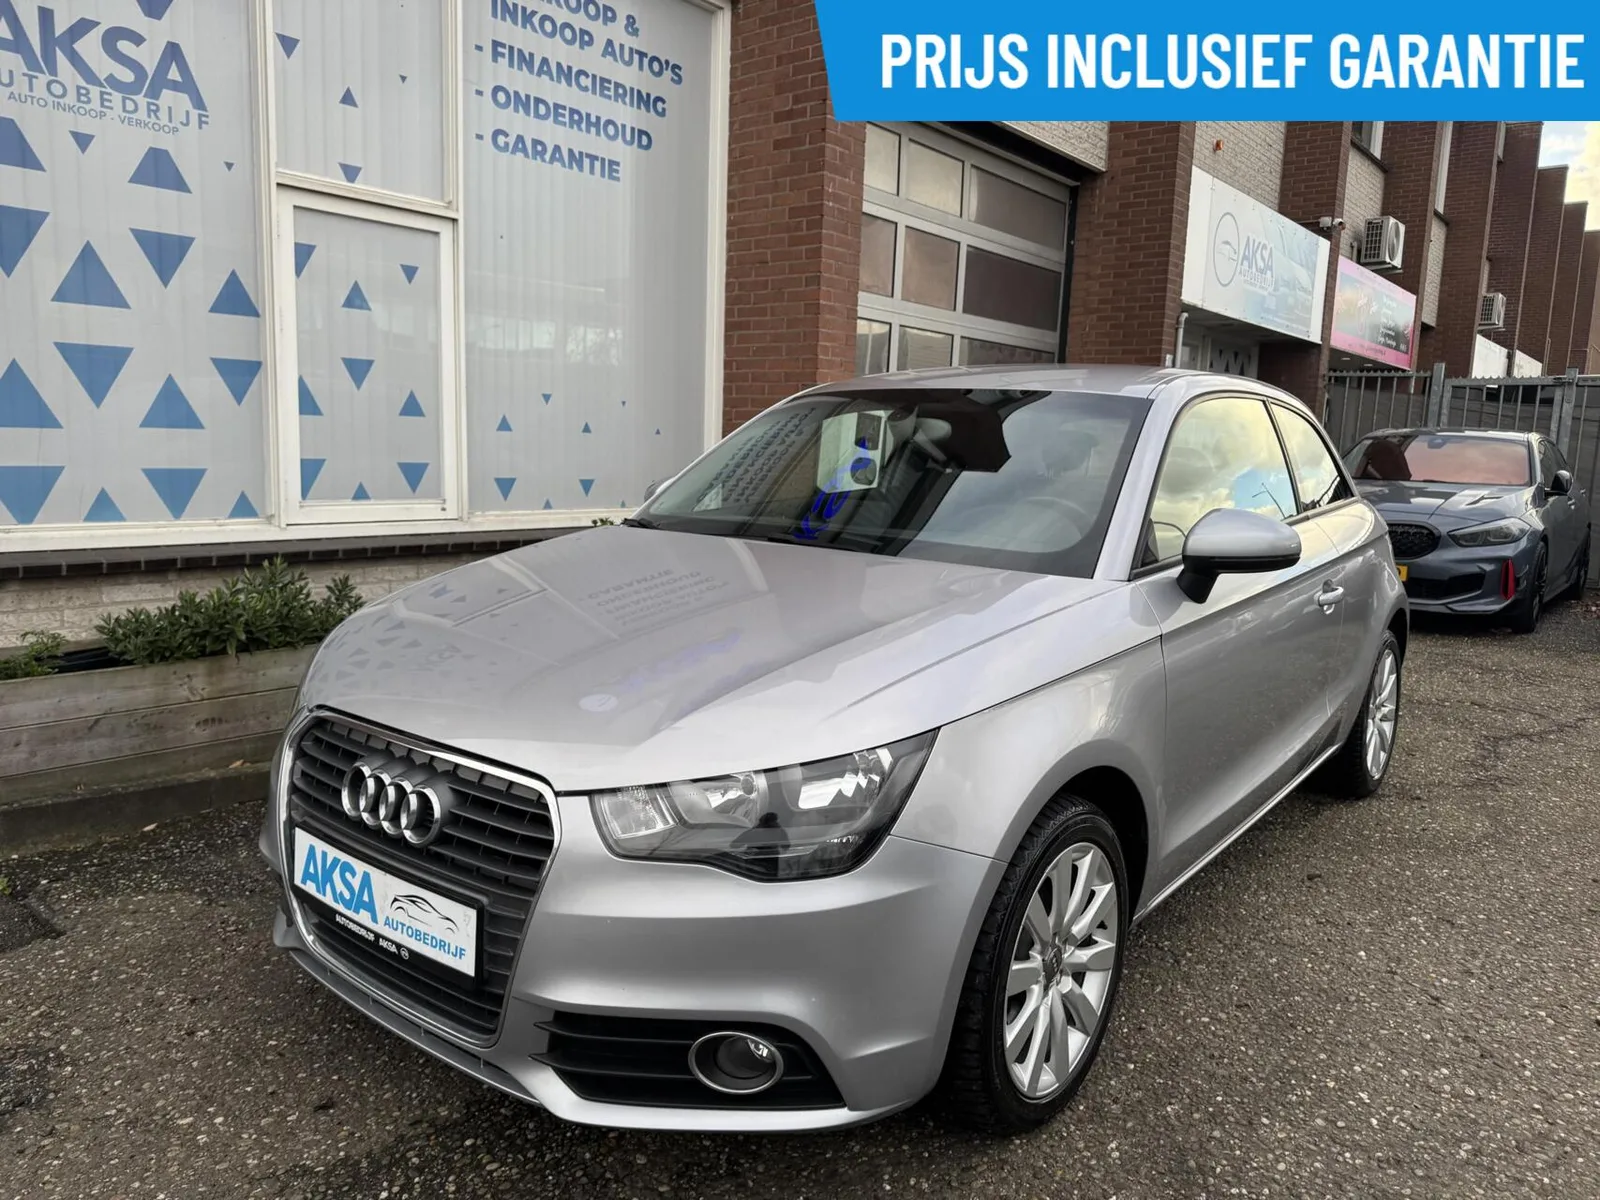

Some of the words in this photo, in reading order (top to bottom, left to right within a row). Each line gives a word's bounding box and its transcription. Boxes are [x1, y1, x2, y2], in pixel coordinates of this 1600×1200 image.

[491, 0, 594, 50] INKOOP
[601, 38, 683, 85] AUTO'S
[624, 14, 640, 38] &
[0, 0, 208, 113] AKSA
[491, 39, 667, 118] FINANCIERING
[0, 68, 210, 130] UTOBEDRIJF
[8, 91, 48, 109] AUTO
[52, 100, 107, 120] INKOOP
[118, 114, 179, 136] VERKOOP
[491, 84, 653, 151] ONDERHOUD
[491, 128, 621, 182] GARANTIE
[1240, 235, 1274, 279] AKSA
[300, 843, 379, 925] AKSA
[379, 937, 398, 955] AKSA
[383, 915, 466, 960] AUTOBEDRIJF
